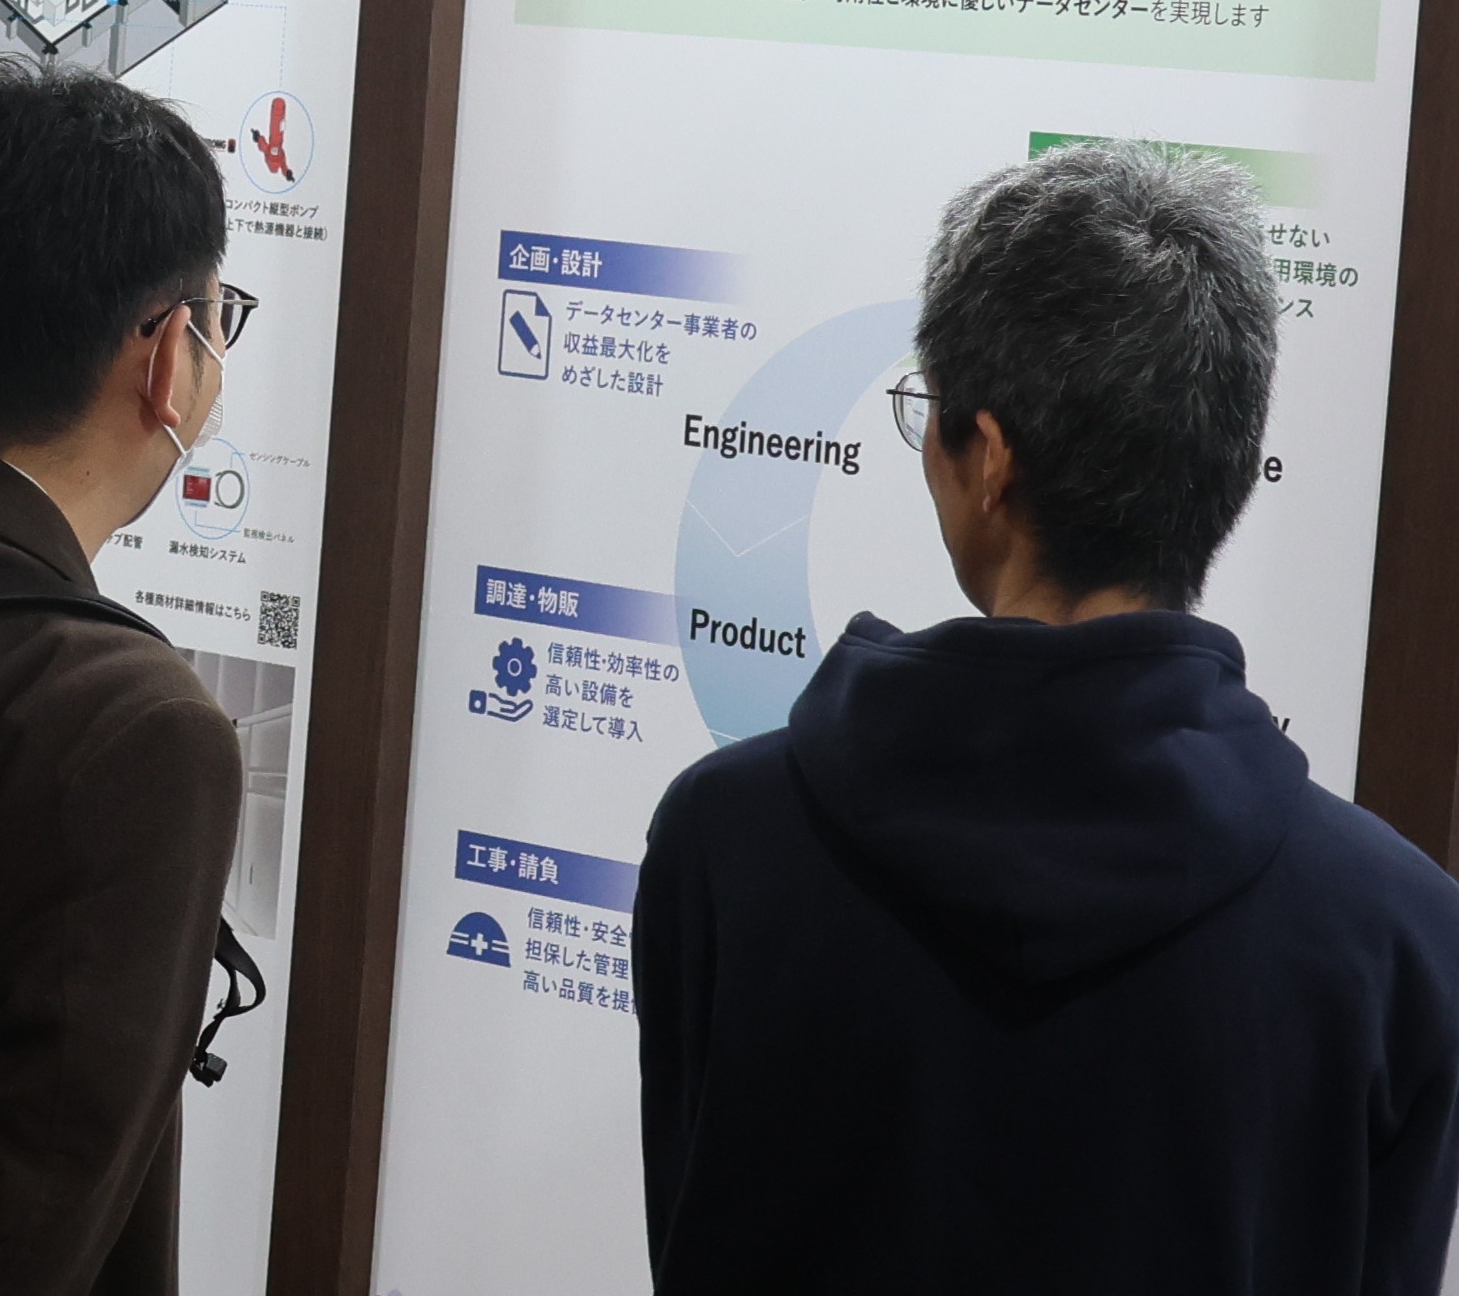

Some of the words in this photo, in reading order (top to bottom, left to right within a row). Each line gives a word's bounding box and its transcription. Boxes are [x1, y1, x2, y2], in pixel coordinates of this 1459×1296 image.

[508, 244, 603, 279] 企画・設計
[565, 300, 758, 343] データセンター事業者の
[563, 332, 672, 366] 収益最大化を
[561, 365, 665, 399] めざした設計
[683, 412, 862, 476] Engineering
[485, 578, 580, 620] 調達・物販
[689, 607, 808, 660] Product
[546, 641, 680, 684] 信頼性・効率性の
[544, 675, 634, 709] 高い設備を
[542, 706, 644, 745] 選定して導入
[466, 843, 559, 885] 工事・請負
[527, 906, 633, 948] 信頼性・安全
[523, 969, 637, 1015] 高い品質を提
